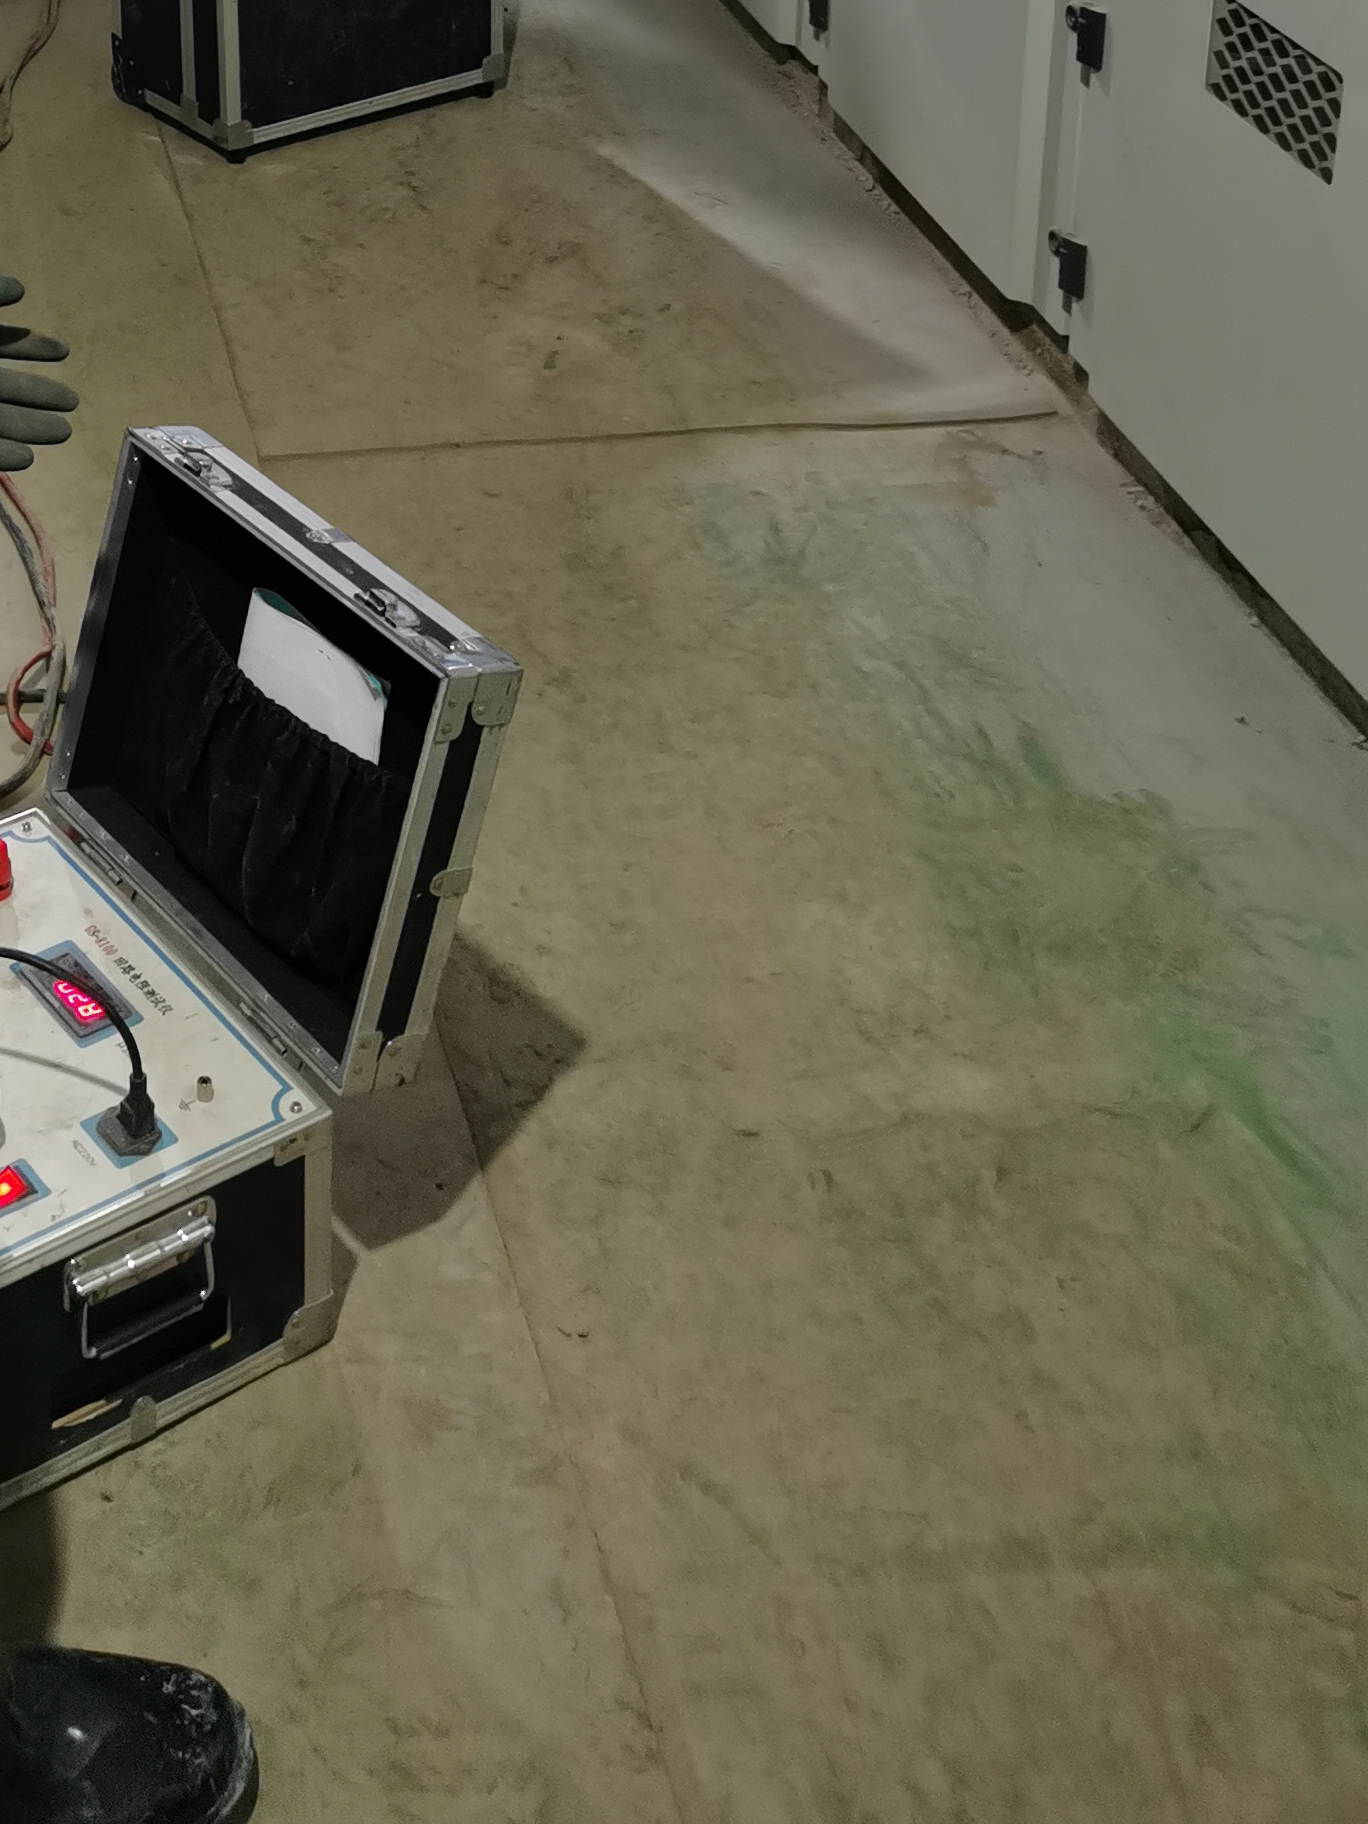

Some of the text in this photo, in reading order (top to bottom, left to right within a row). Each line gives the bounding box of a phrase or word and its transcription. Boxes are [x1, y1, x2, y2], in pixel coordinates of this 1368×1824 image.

[113, 956, 174, 1016] 回路电阻测试仪
